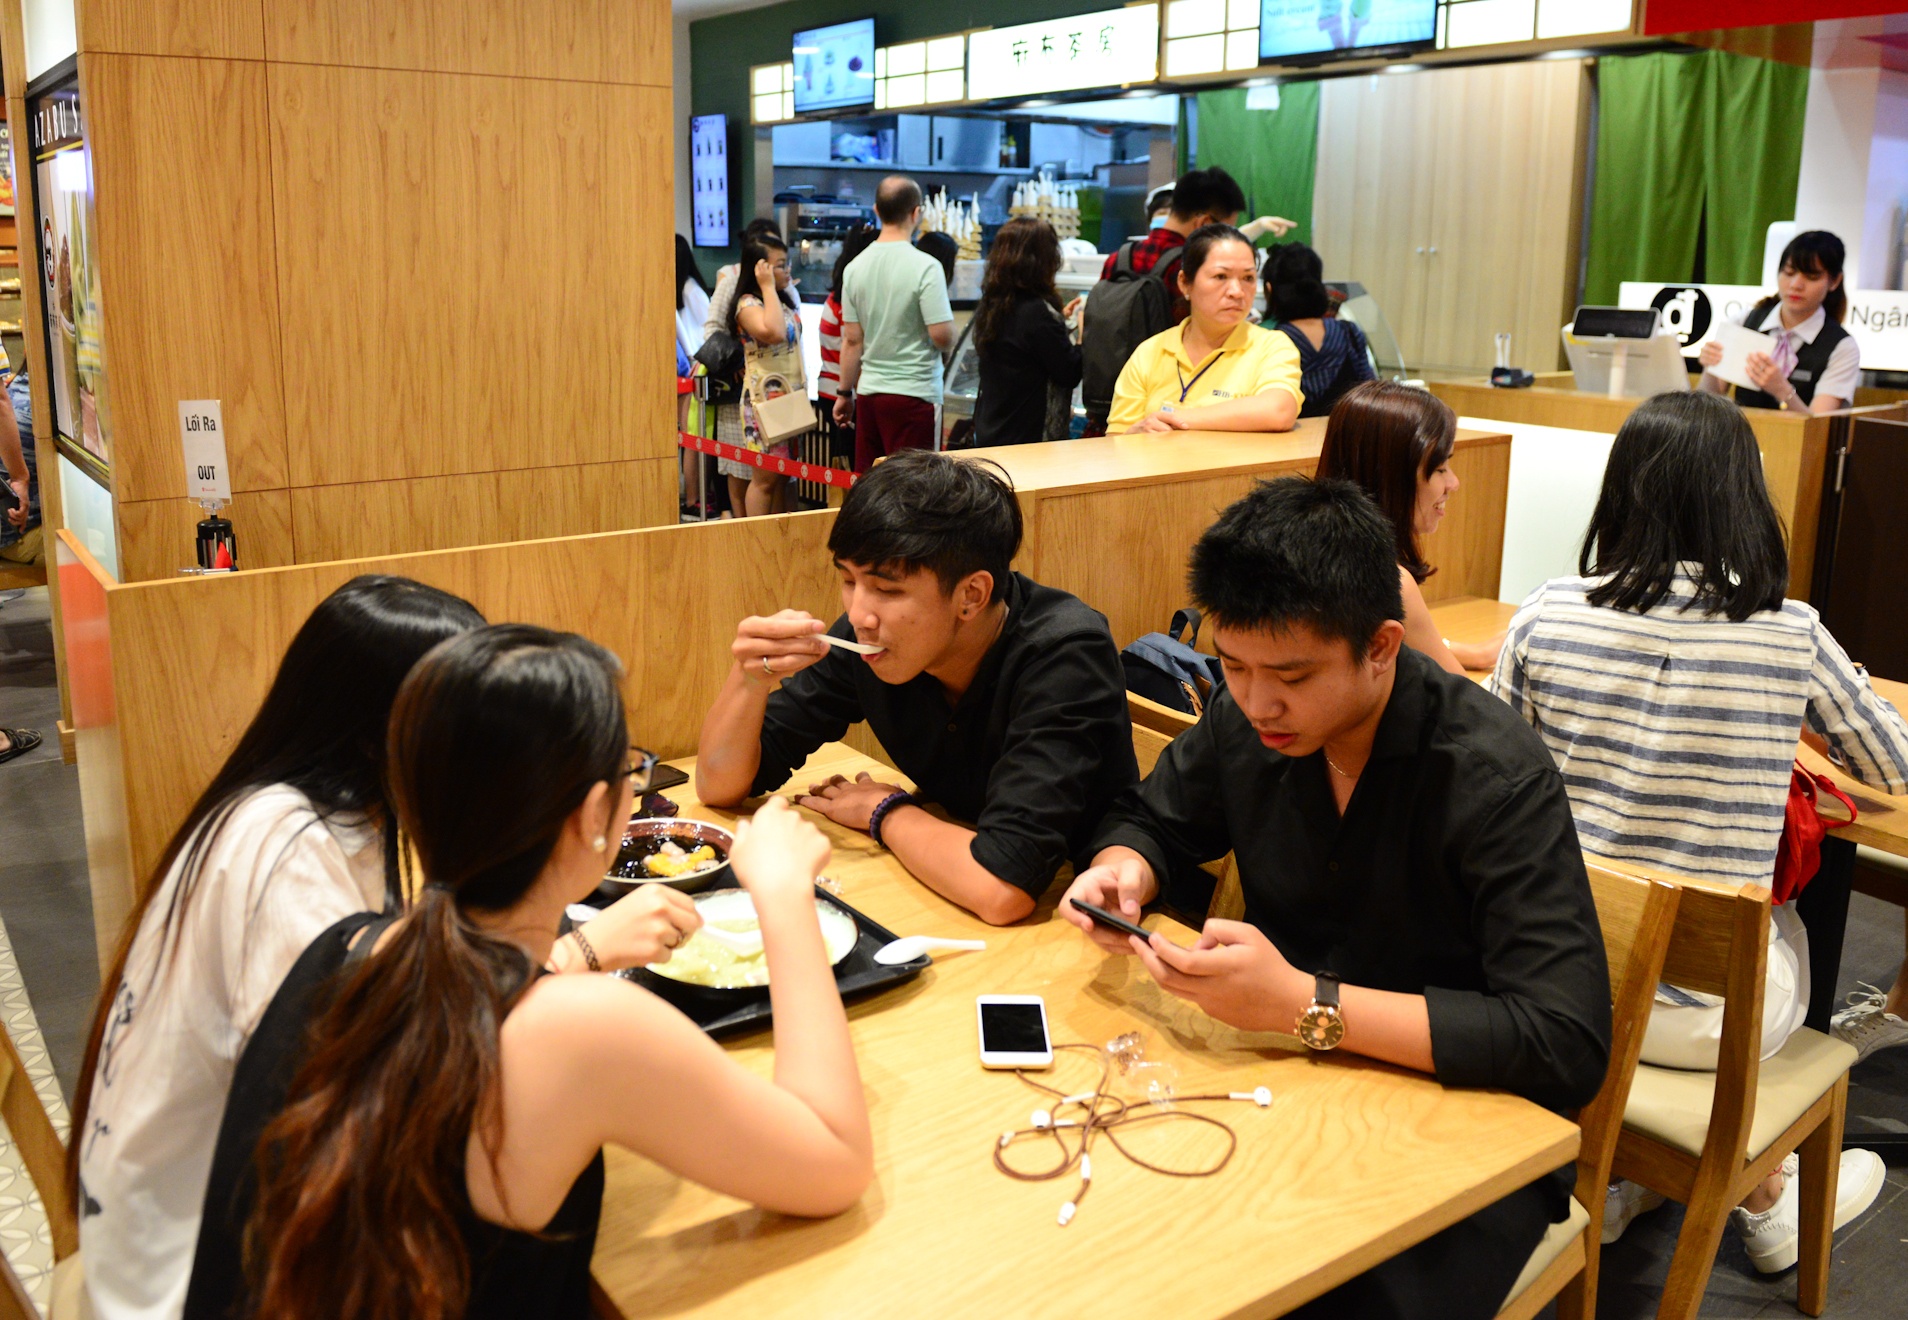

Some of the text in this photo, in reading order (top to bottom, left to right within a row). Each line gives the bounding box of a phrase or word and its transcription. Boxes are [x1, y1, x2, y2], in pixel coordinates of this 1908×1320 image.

[34, 93, 83, 149] AZABU S
[185, 414, 216, 431] Lối Ra
[197, 465, 216, 481] OUT
